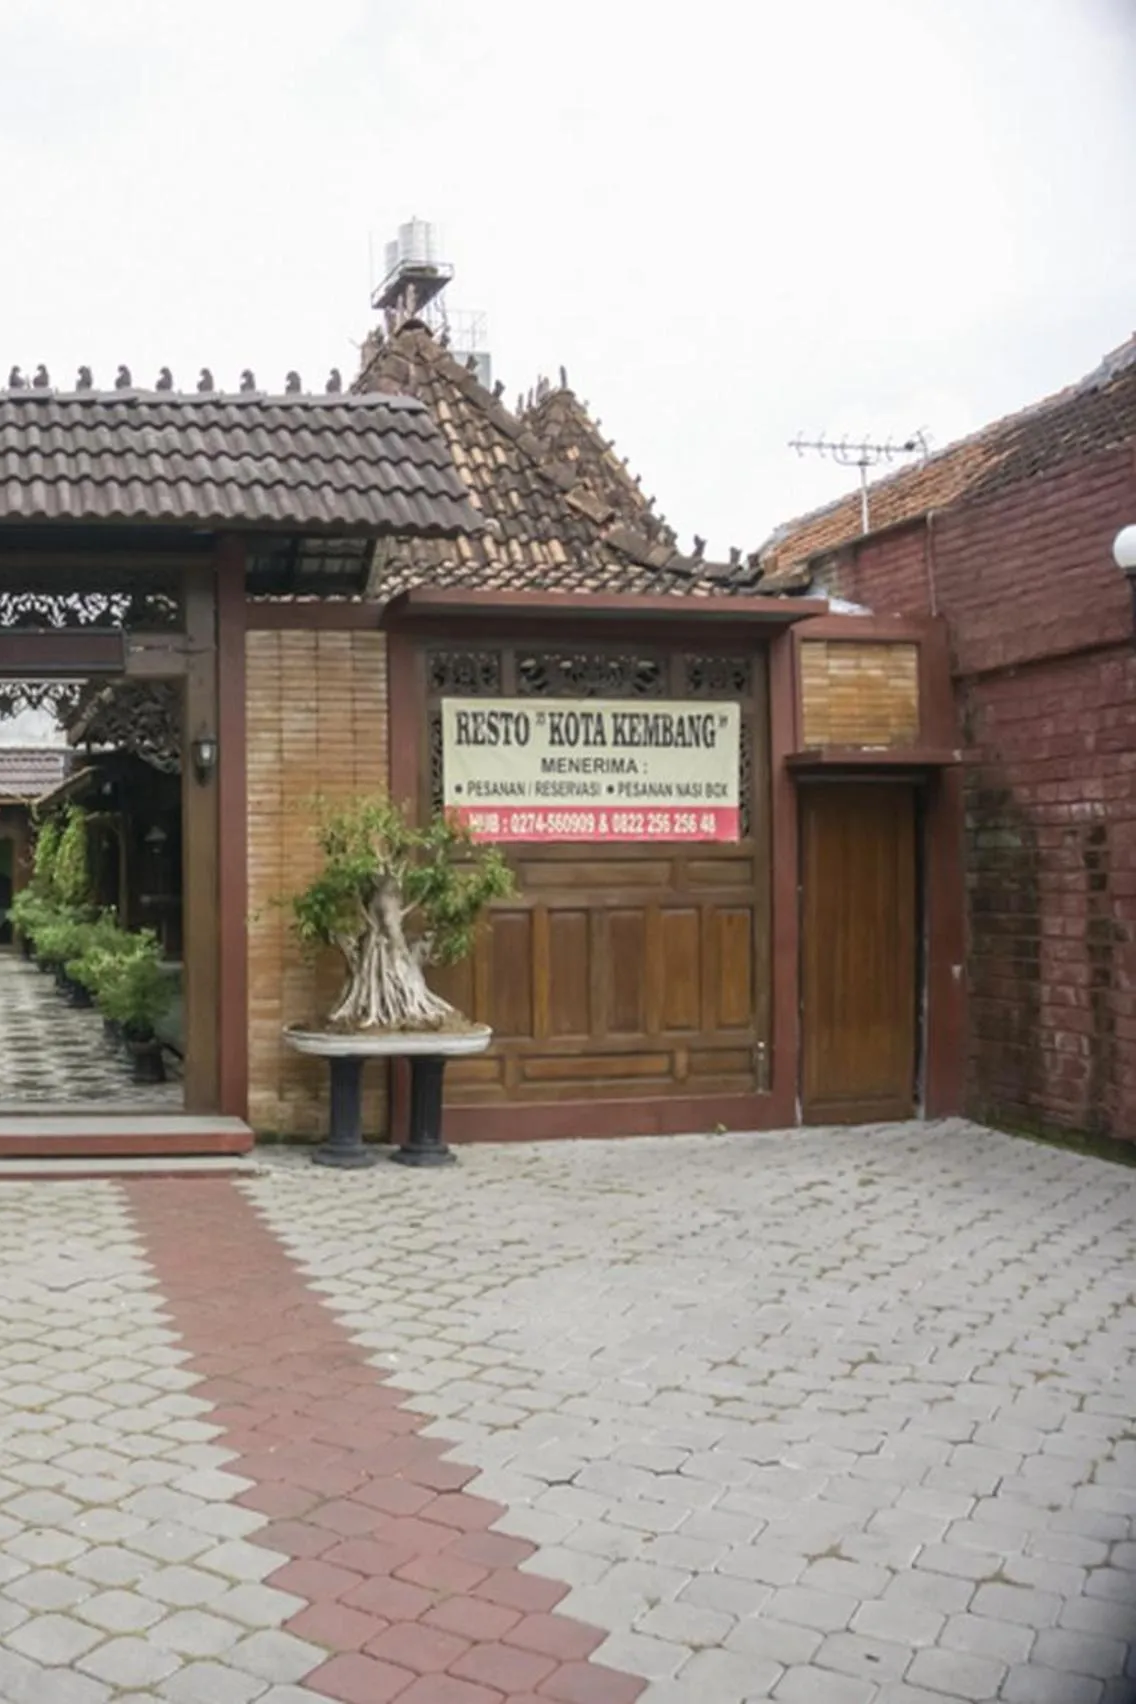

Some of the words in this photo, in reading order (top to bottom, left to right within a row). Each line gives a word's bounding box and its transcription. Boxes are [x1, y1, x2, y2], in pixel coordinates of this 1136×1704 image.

[455, 710, 530, 746] RESTO
[541, 757, 639, 774] MENERIMA
[467, 780, 525, 797] PESANAN
[617, 781, 673, 798] PESANAN
